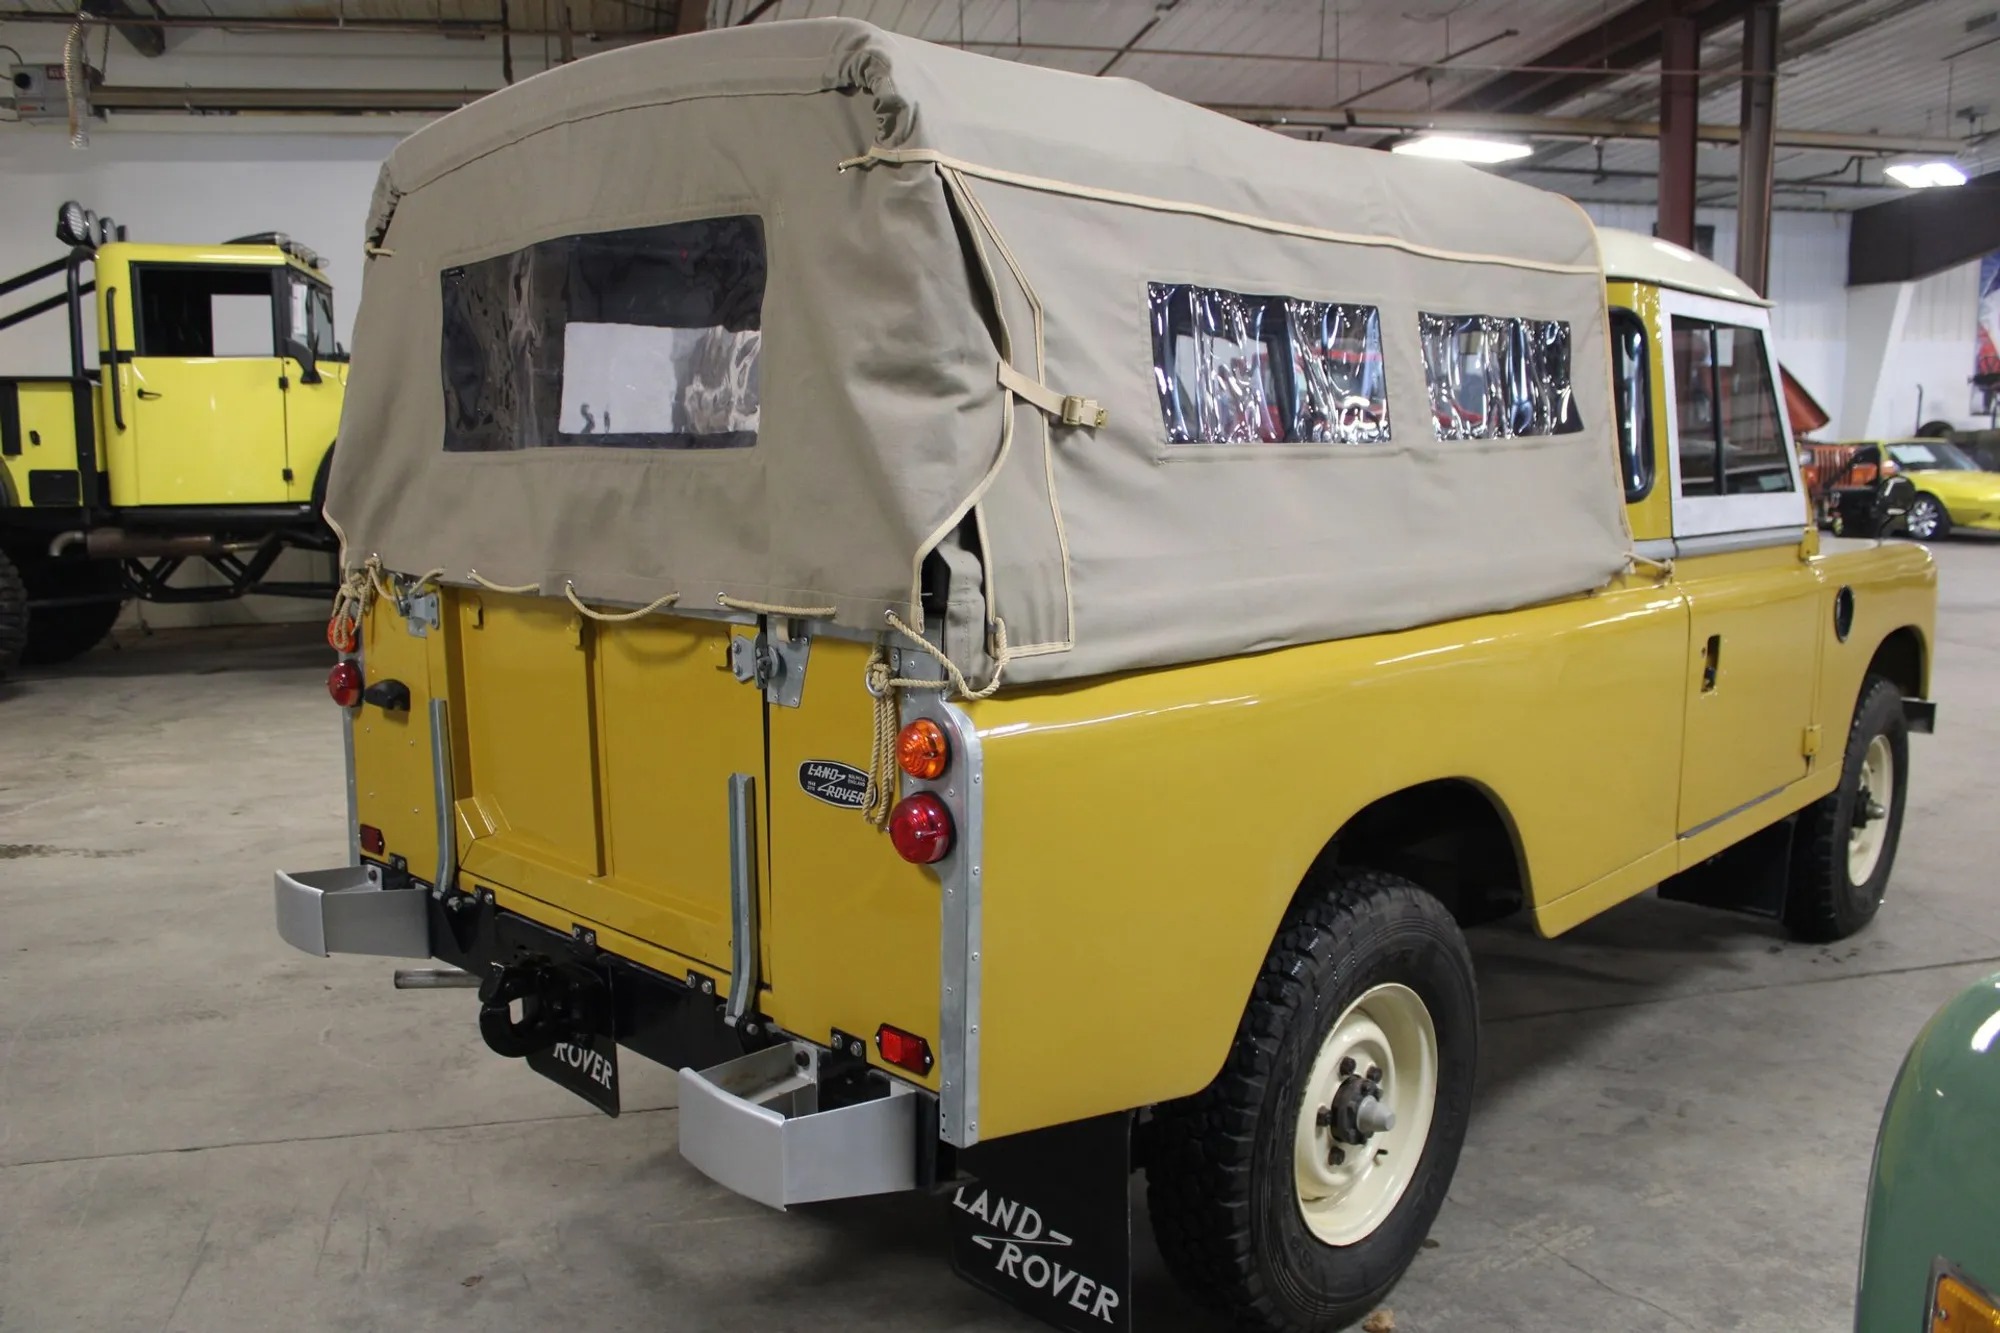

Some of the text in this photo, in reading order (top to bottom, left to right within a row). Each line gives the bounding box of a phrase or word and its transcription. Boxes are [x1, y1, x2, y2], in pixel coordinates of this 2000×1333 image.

[807, 764, 839, 780] LAND
[826, 785, 864, 804] ROVER
[552, 1042, 613, 1090] ROVER
[952, 1186, 1042, 1240] LAND
[995, 1241, 1120, 1325] ROVER
